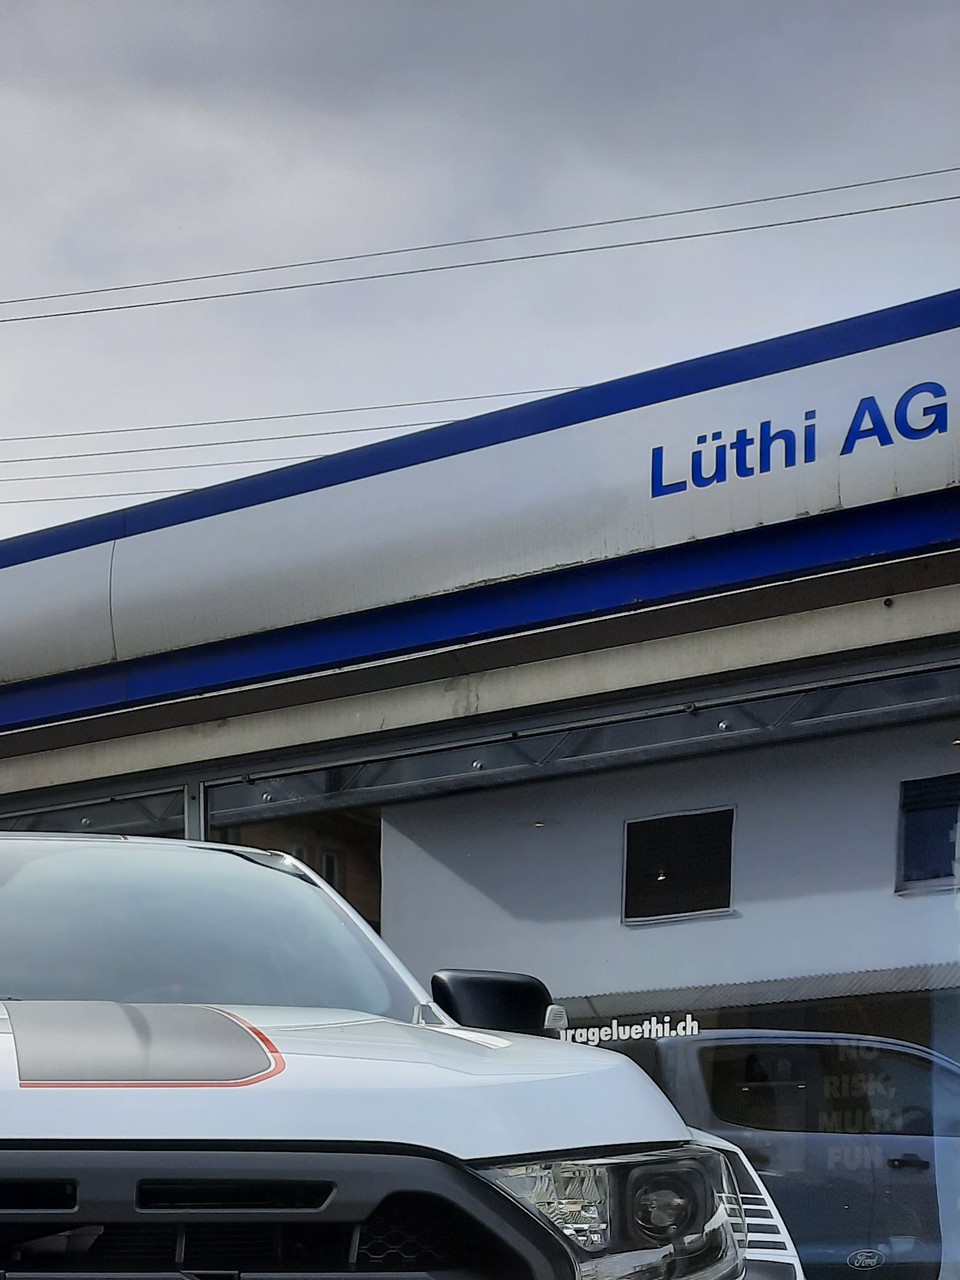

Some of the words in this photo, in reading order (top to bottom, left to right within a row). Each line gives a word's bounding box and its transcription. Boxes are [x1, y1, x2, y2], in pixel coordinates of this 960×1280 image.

[650, 410, 816, 499] Lüthi
[839, 381, 949, 456] AG
[827, 1145, 883, 1170] FUN
